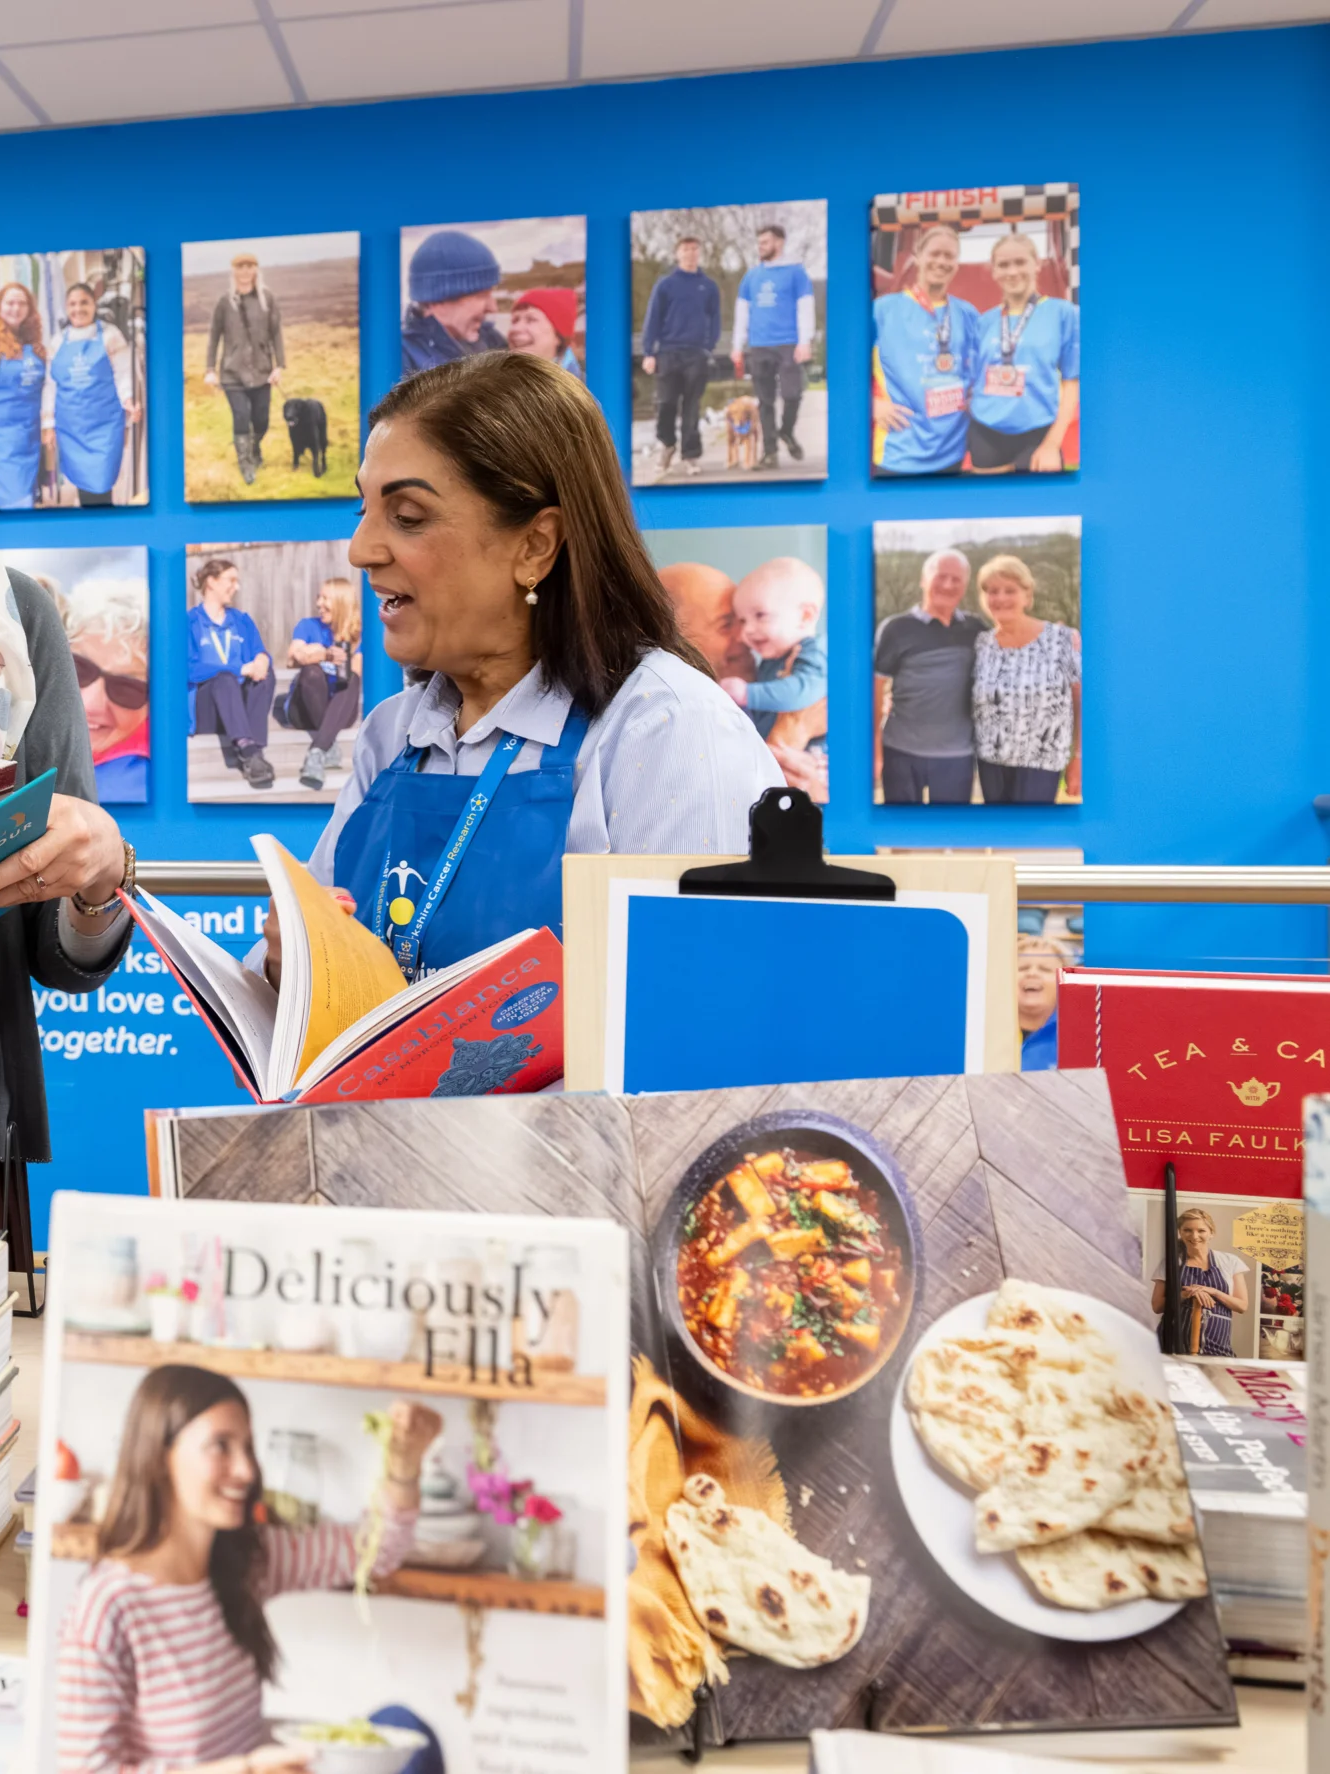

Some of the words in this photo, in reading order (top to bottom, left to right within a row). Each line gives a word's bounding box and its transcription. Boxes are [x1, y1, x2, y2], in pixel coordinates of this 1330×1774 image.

[905, 187, 999, 209] FINISH
[428, 861, 453, 901] Cancer
[446, 812, 477, 861] Research
[183, 905, 245, 935] and
[32, 990, 89, 1018] you
[97, 985, 165, 1014] love
[337, 956, 542, 1097] Casablanca
[500, 986, 546, 1016] OBSERVER
[377, 1071, 396, 1086] MY
[399, 1014, 478, 1070] MOROCCAN
[481, 987, 520, 1014] FOOD
[1127, 1042, 1207, 1081] TEA
[1231, 1037, 1250, 1053] &
[1276, 1040, 1326, 1069] CA
[1127, 1127, 1193, 1145] LISA
[1208, 1132, 1307, 1152] FAULK
[223, 1246, 560, 1348] Deliciously
[422, 1325, 535, 1388] Ella
[1225, 1368, 1307, 1427] Mary
